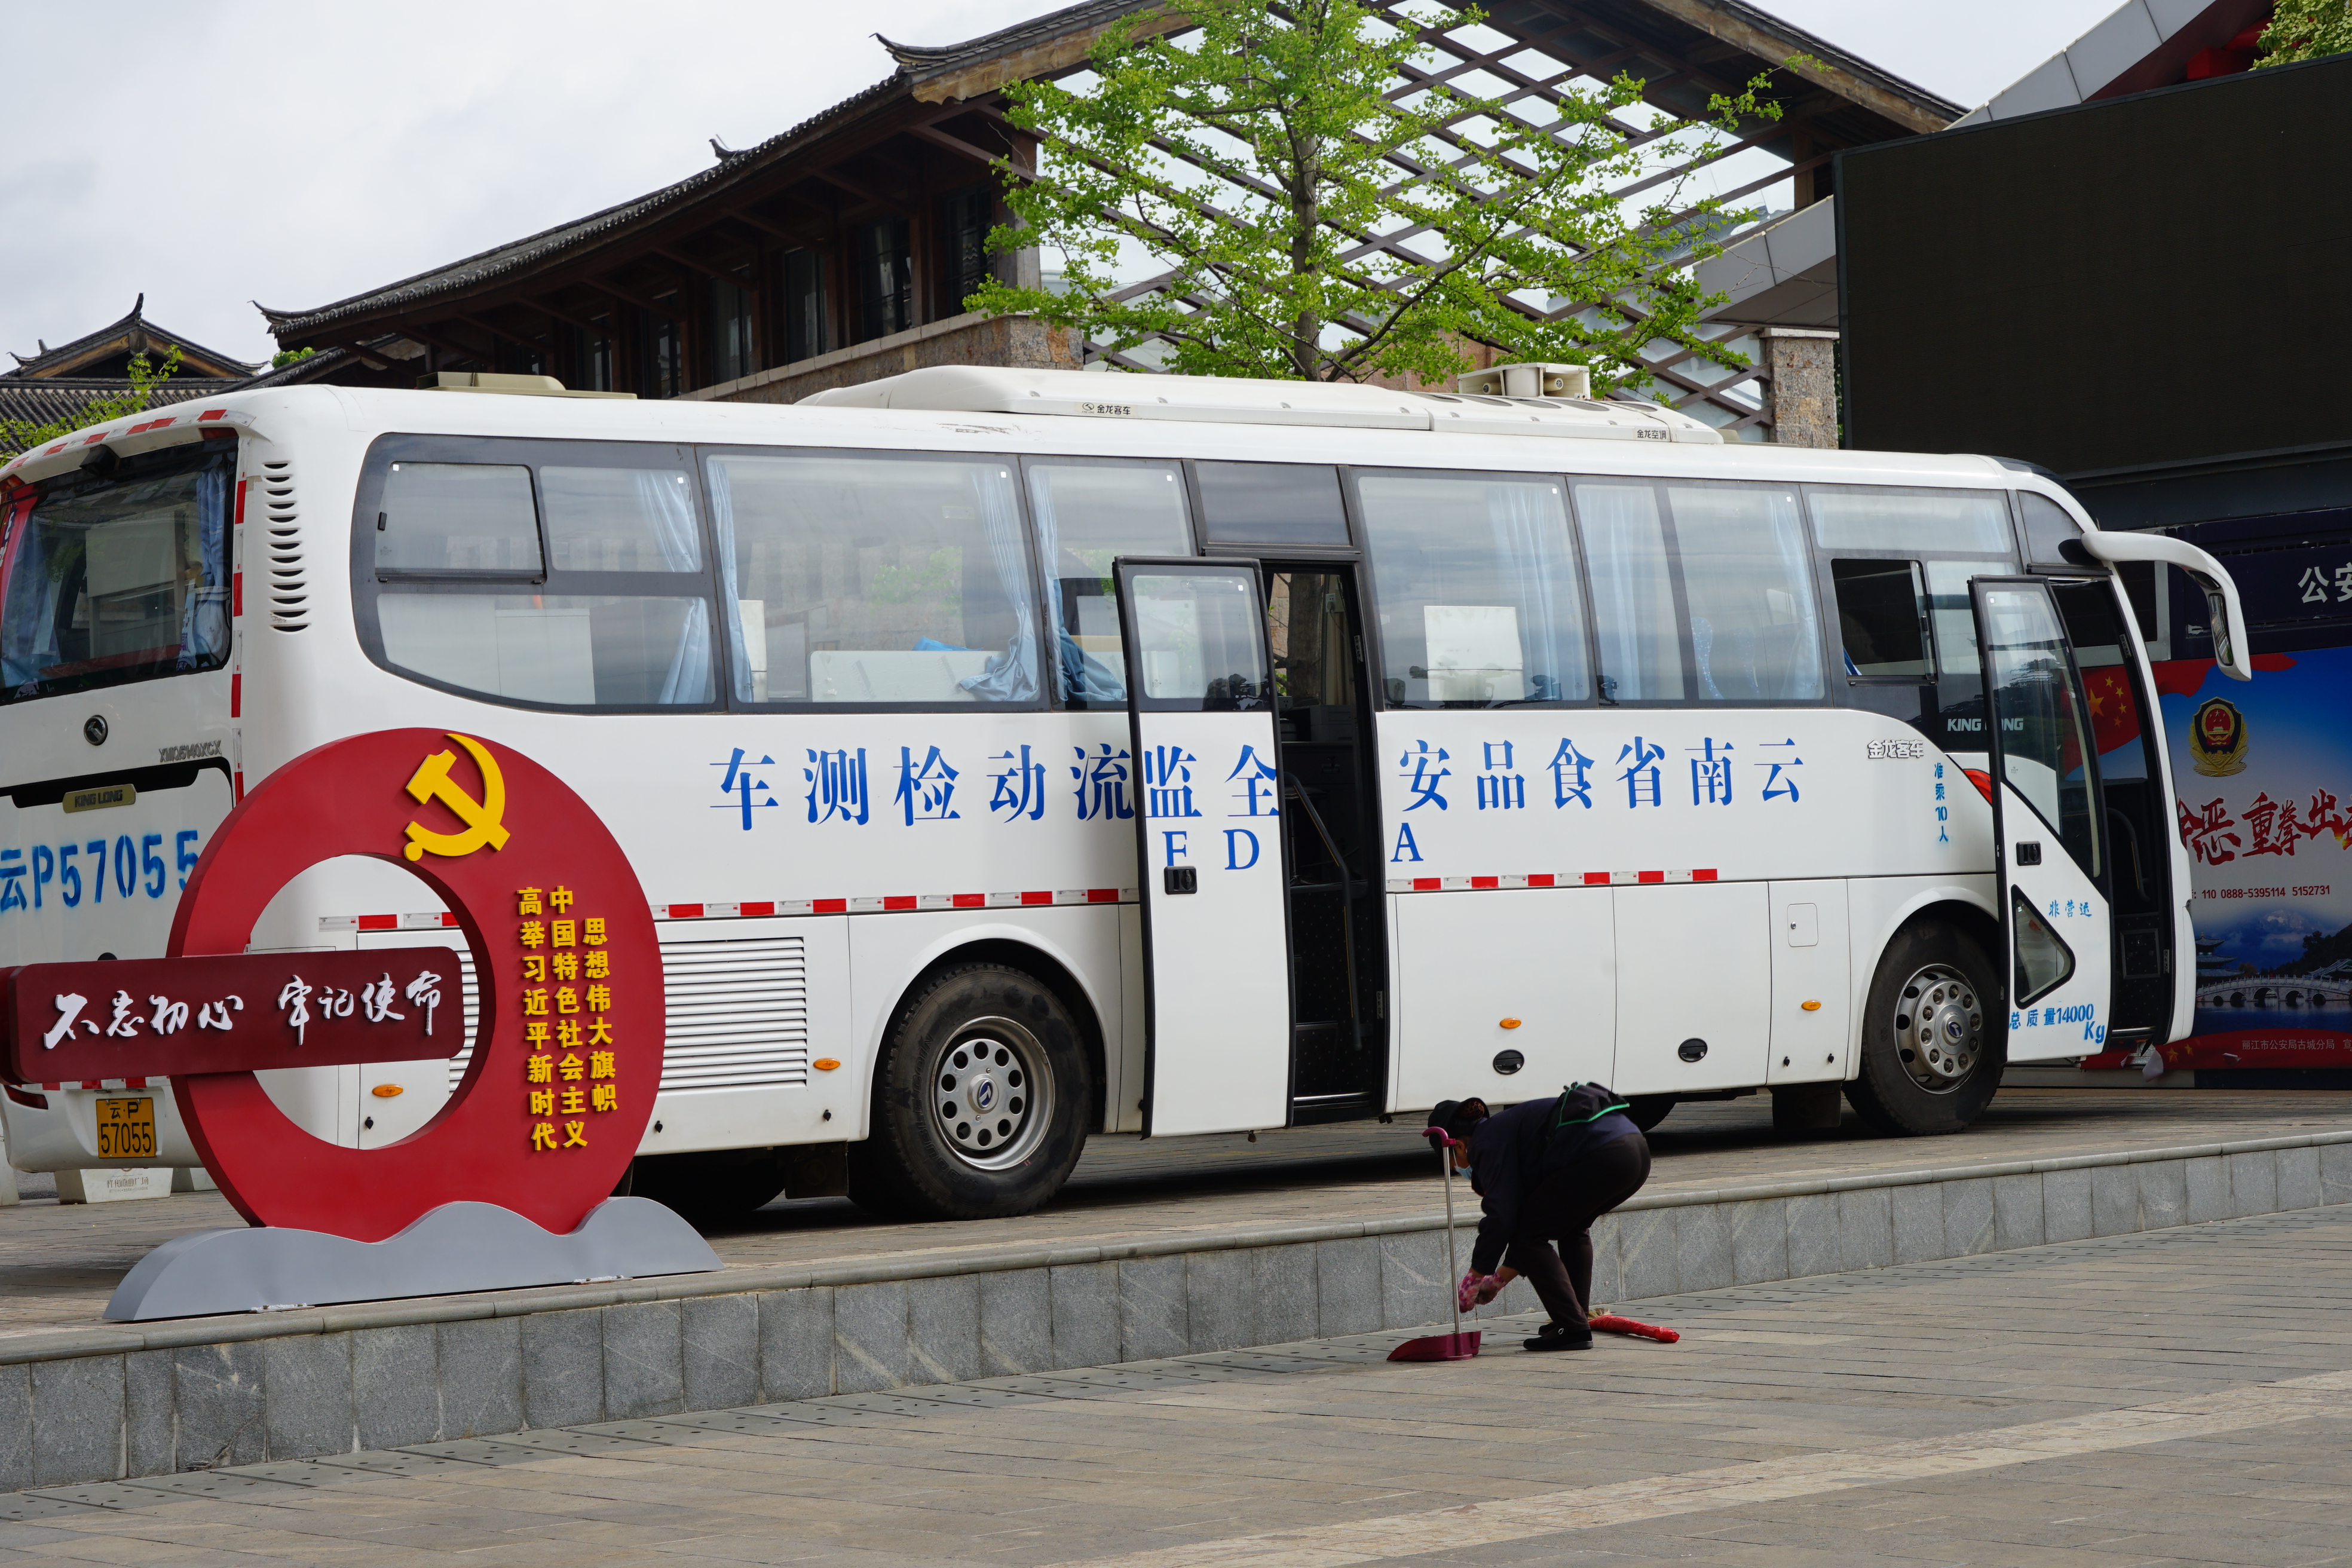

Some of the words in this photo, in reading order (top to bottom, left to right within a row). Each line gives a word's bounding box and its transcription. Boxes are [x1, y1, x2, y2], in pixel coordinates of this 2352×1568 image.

[1097, 405, 1131, 415] 金龙客车
[1637, 429, 1667, 439] 金龙空调
[1947, 718, 1982, 731] KING
[1984, 718, 2024, 731] NG
[158, 740, 222, 762] XMQ5140XCX
[1867, 739, 1924, 759] 金龙客车
[75, 793, 96, 807] KING
[98, 789, 122, 804] LONG
[1934, 762, 1949, 843] 准乘10人
[2202, 889, 2216, 899] 110
[2221, 887, 2286, 899] 0888-5395114
[2292, 885, 2330, 896] 5152731
[2048, 899, 2092, 918] 非营运
[44, 990, 244, 1049] 不忘初心
[278, 970, 442, 1045] 牢记使命
[517, 886, 557, 1151] 高举习近平新时代
[549, 886, 588, 1149] 中国特色社会主义
[583, 918, 618, 1111] 思想伟大旗帜
[2084, 1021, 2105, 1044] Kg
[2242, 1039, 2335, 1050] 丽江市公安局古城分局
[100, 1122, 151, 1154] 57055
